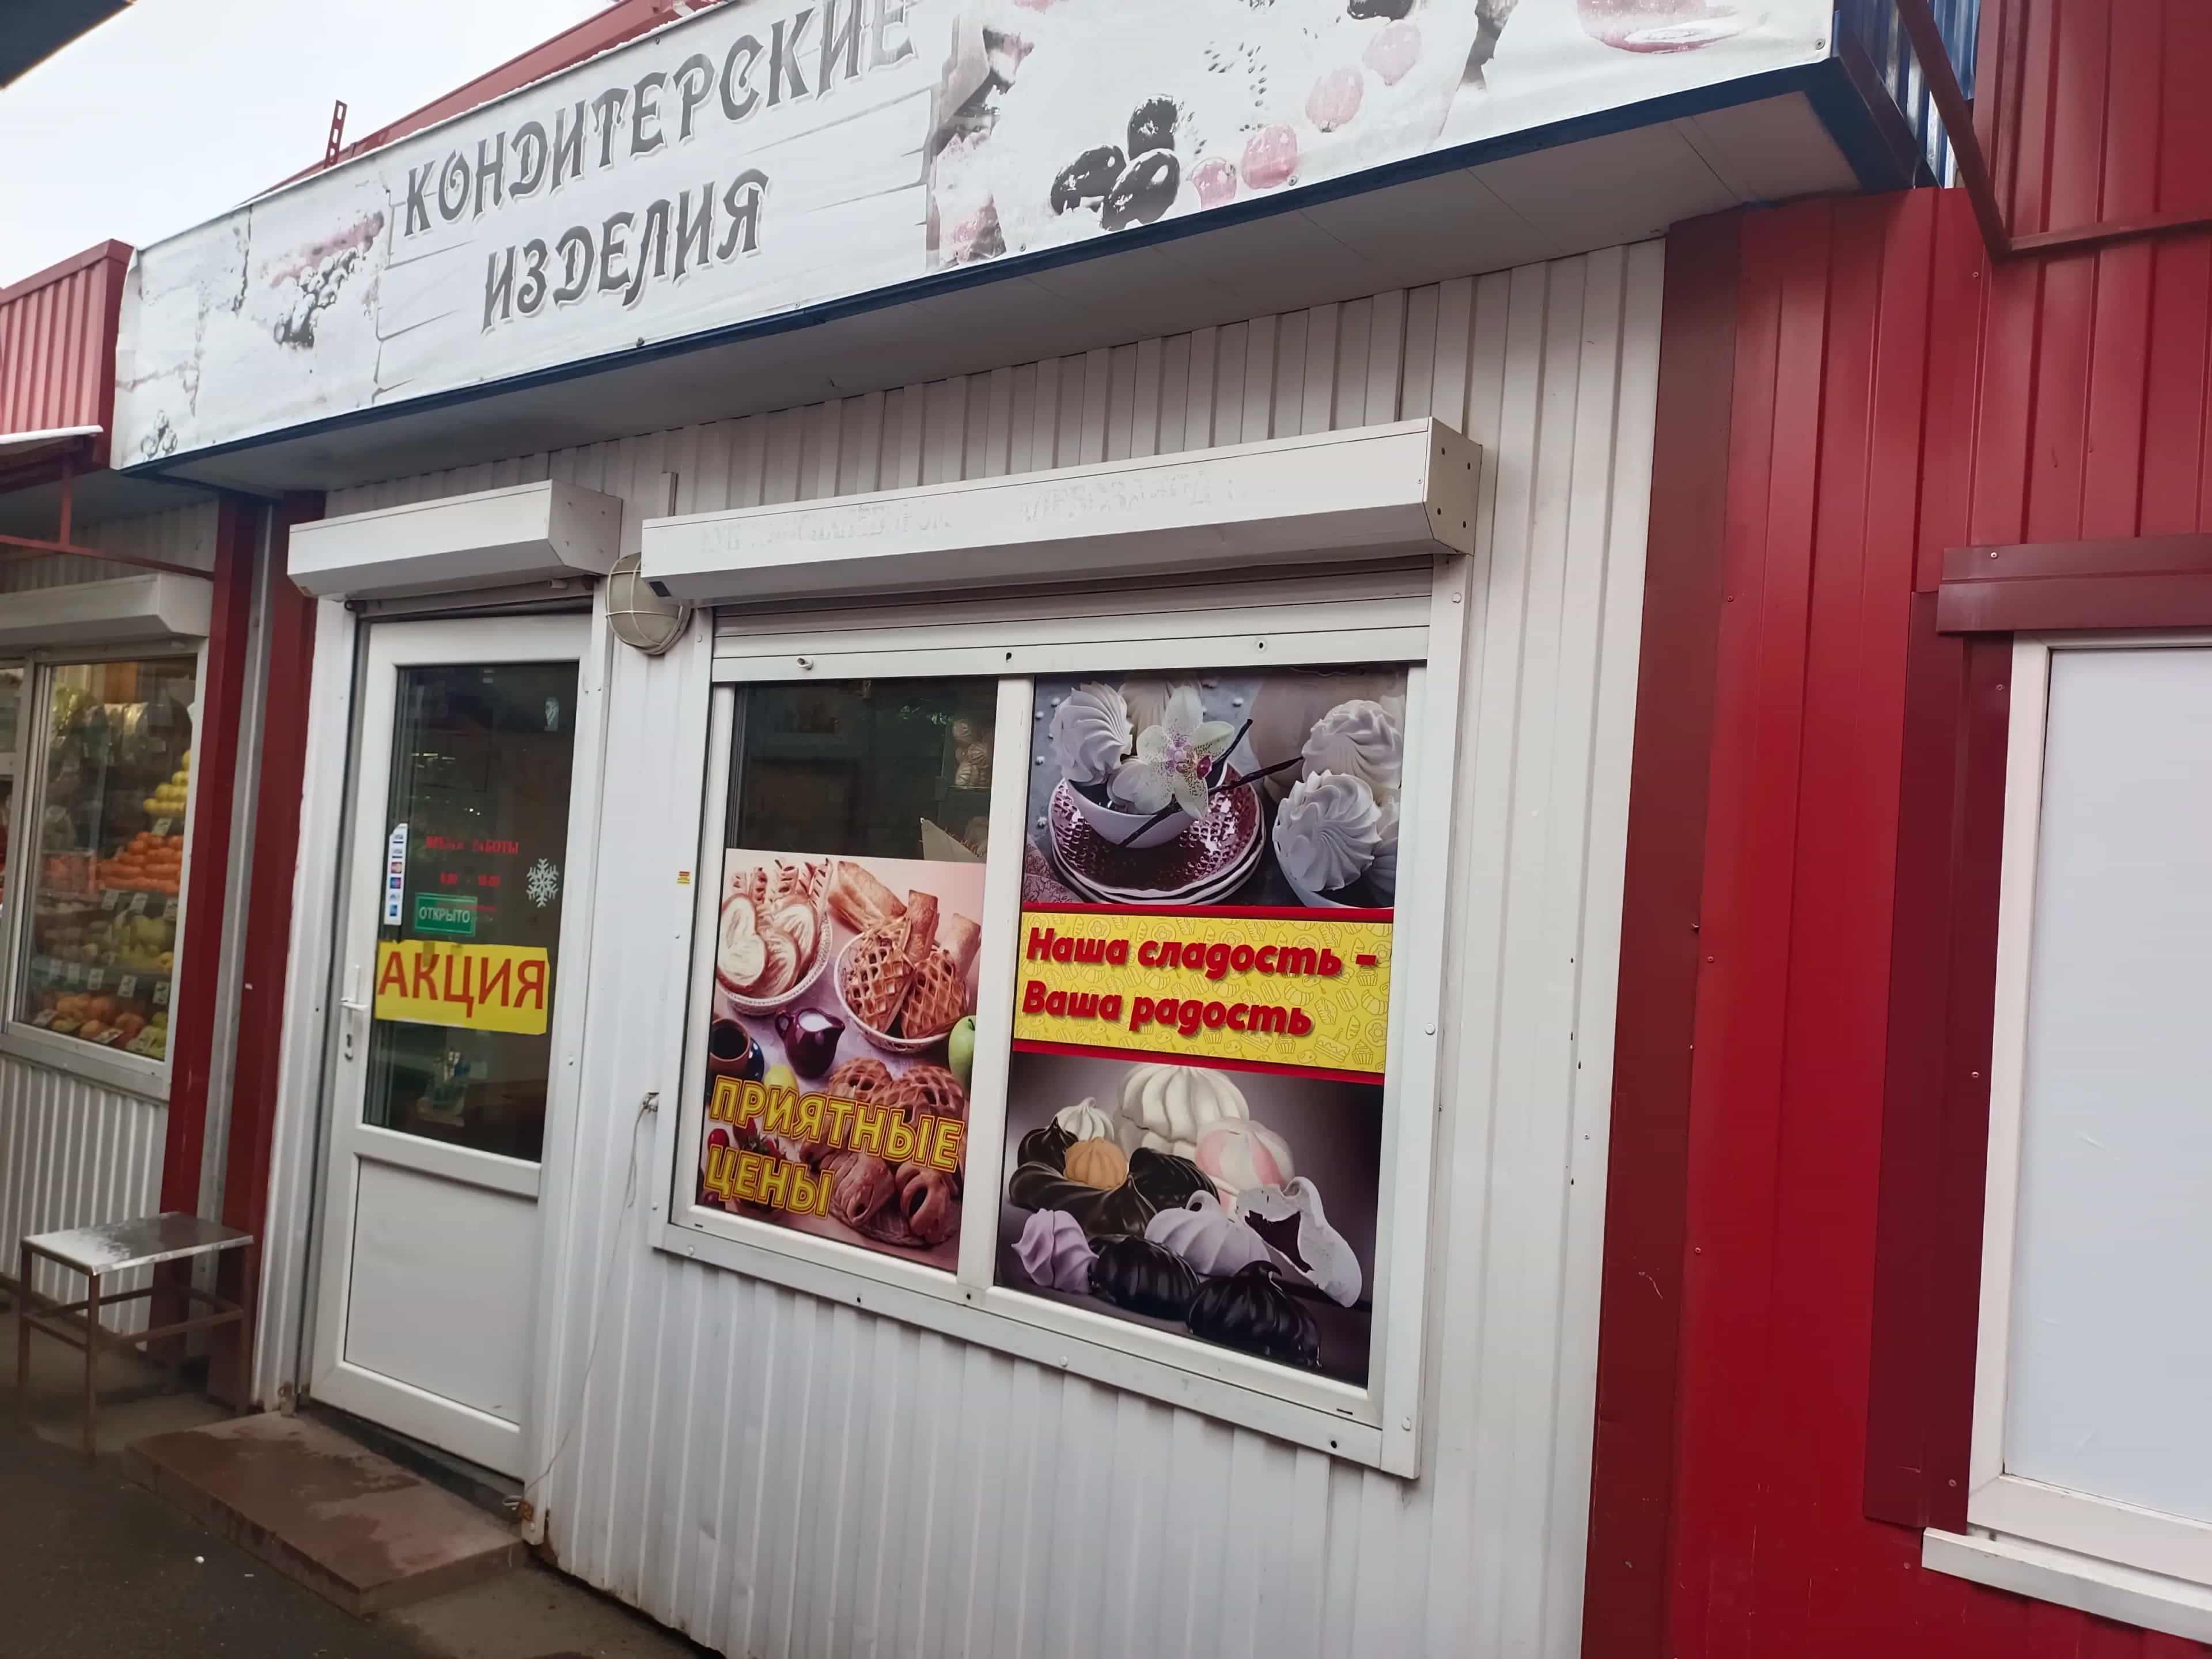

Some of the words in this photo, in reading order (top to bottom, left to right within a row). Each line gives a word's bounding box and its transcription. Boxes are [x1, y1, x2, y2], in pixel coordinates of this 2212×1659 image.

[404, 0, 916, 238] КОНДИТЕРСКИЕ
[482, 168, 769, 334] ИЗДЕЛИЯ
[419, 907, 470, 923] ОТКРЫТО
[377, 951, 546, 1018] АКЦИЯ
[1026, 927, 1129, 965] Наша
[1138, 940, 1342, 979] сладость
[1022, 980, 1122, 1020] Ваша
[1129, 996, 1314, 1036] радость
[710, 1075, 965, 1173] ПРИЯТНЫЕ
[704, 1144, 834, 1219] ЦЕНЫ
